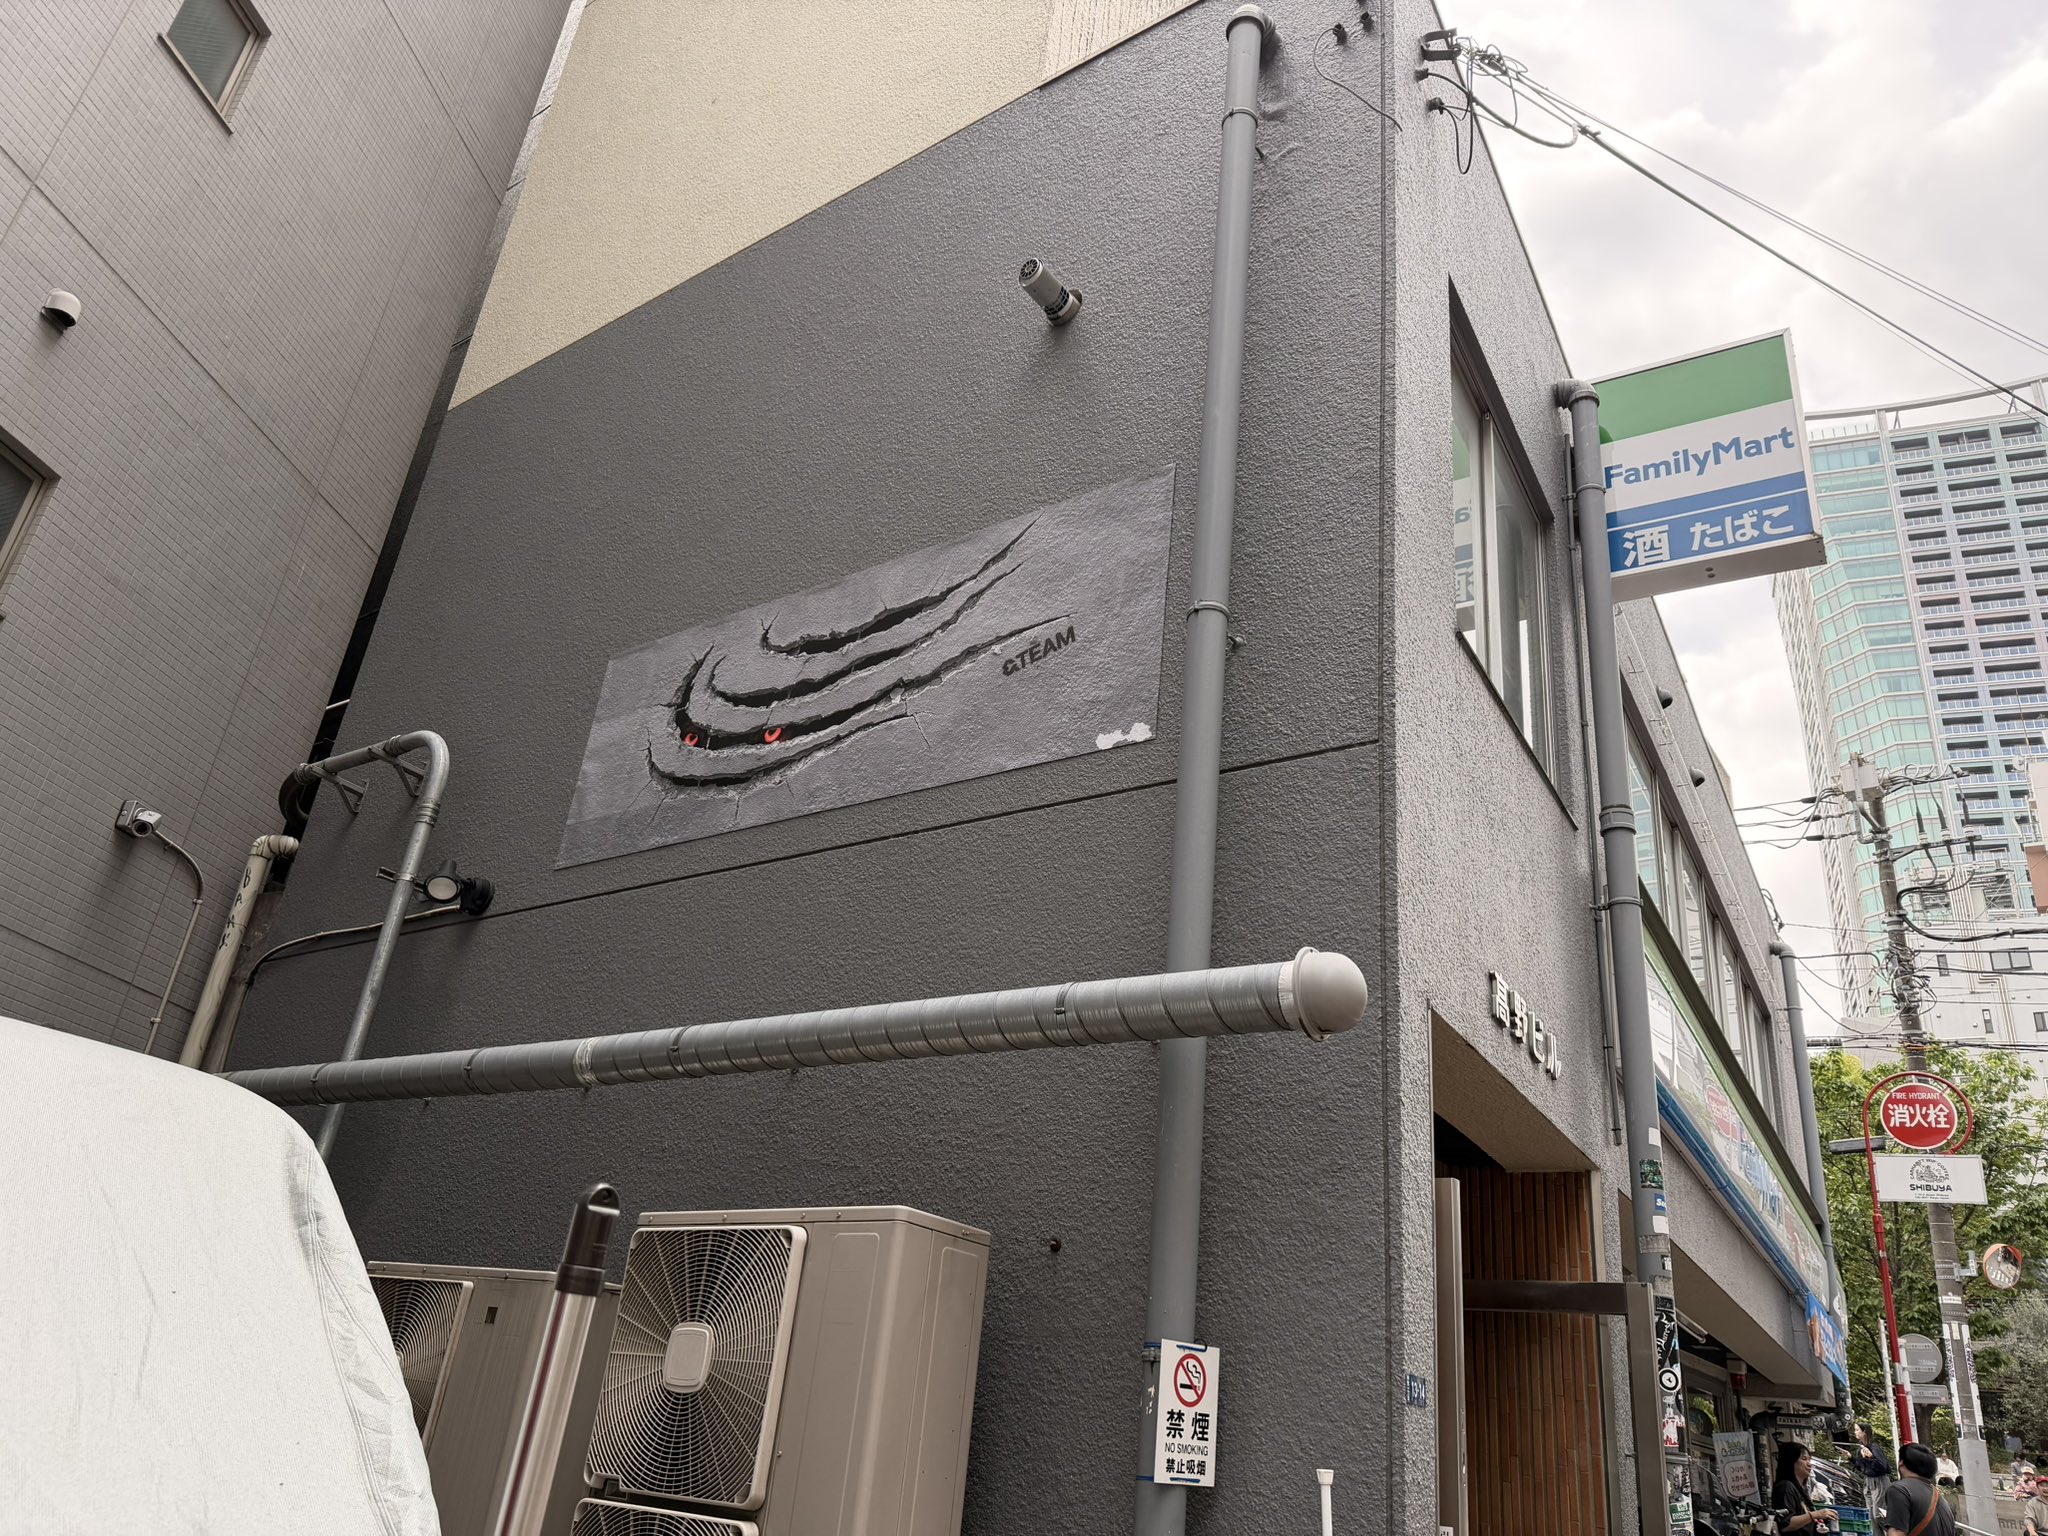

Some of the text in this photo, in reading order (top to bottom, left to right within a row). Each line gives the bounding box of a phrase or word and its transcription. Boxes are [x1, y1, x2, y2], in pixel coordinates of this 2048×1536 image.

[1604, 427, 1795, 489] FamilyMart
[1623, 505, 1794, 568] 酒 たばこ
[1892, 1092, 1941, 1100] FIRE HYDRANT
[1887, 1103, 1951, 1128] 消火栓
[1909, 1183, 1953, 1192] SHIBUYA
[1166, 1408, 1210, 1442] 禁煙
[1164, 1442, 1209, 1456] NO SMOKING
[1165, 1457, 1207, 1476] 禁止吸烟
